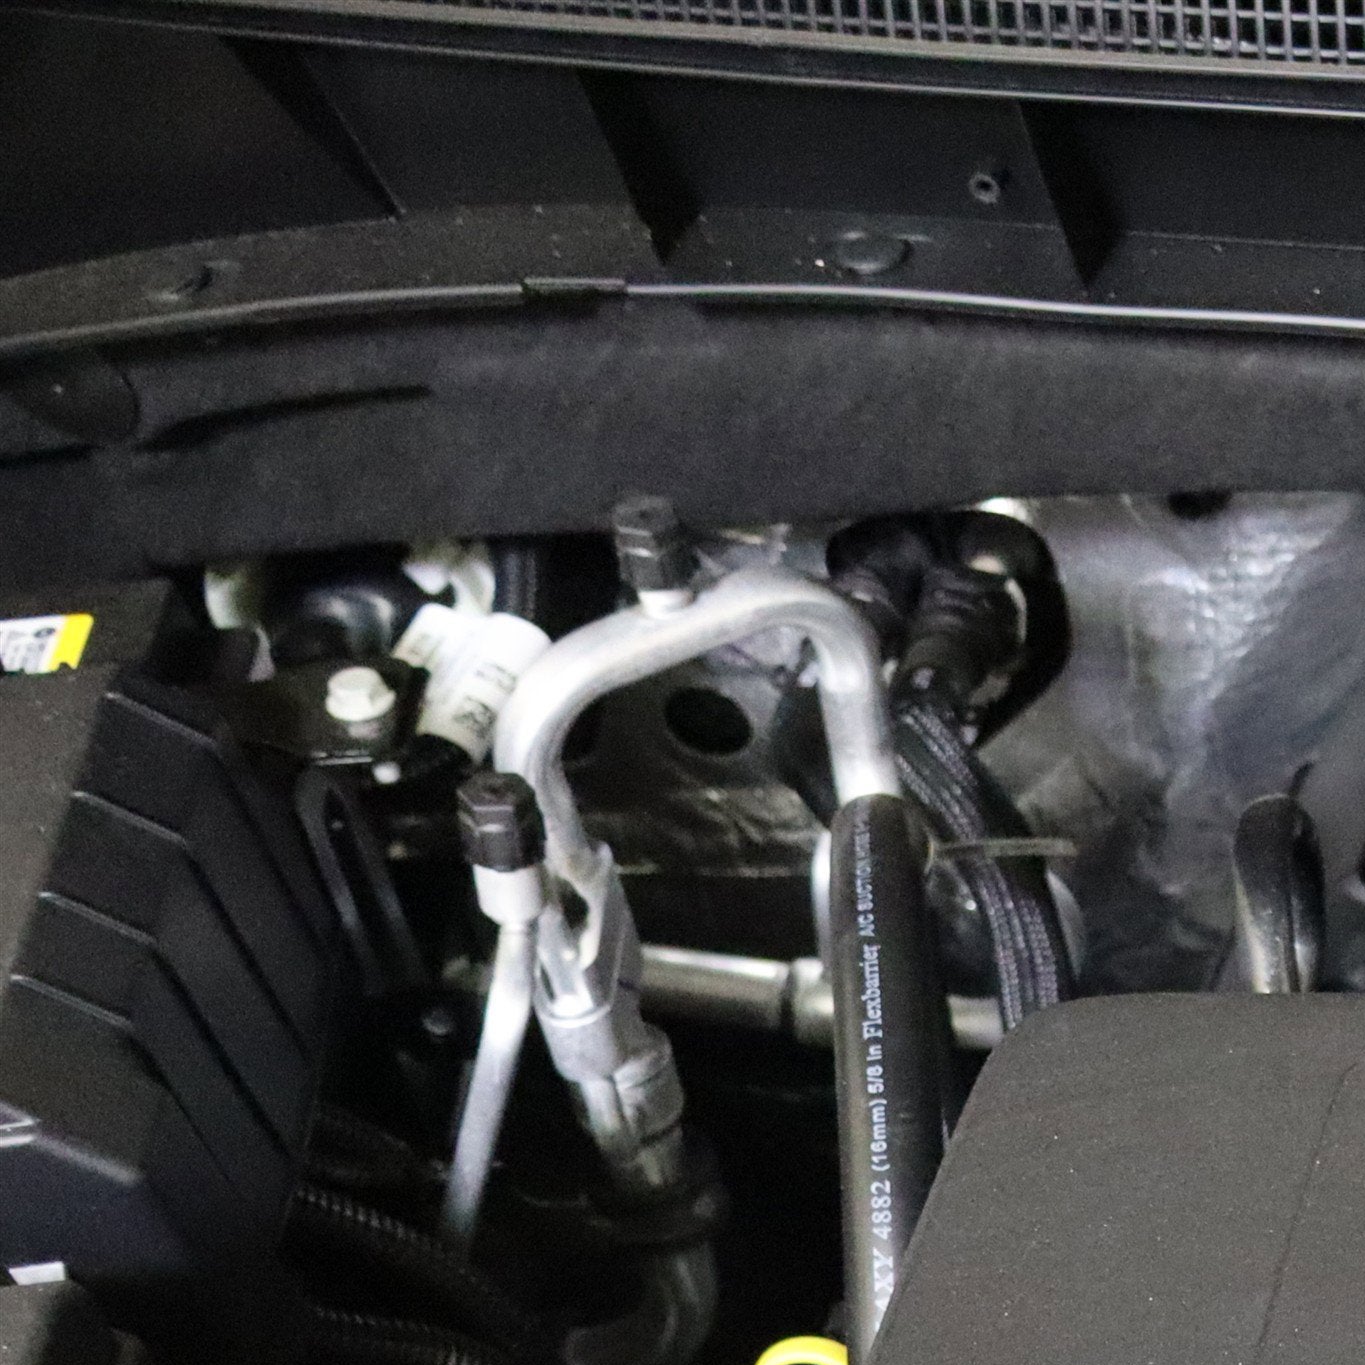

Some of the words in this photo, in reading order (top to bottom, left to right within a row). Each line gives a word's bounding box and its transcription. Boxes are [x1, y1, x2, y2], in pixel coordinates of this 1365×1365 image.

[857, 914, 875, 937] A/C
[869, 1099, 890, 1171] (16mm)
[871, 1179, 892, 1240] 4882
[873, 1247, 894, 1333] AXY
